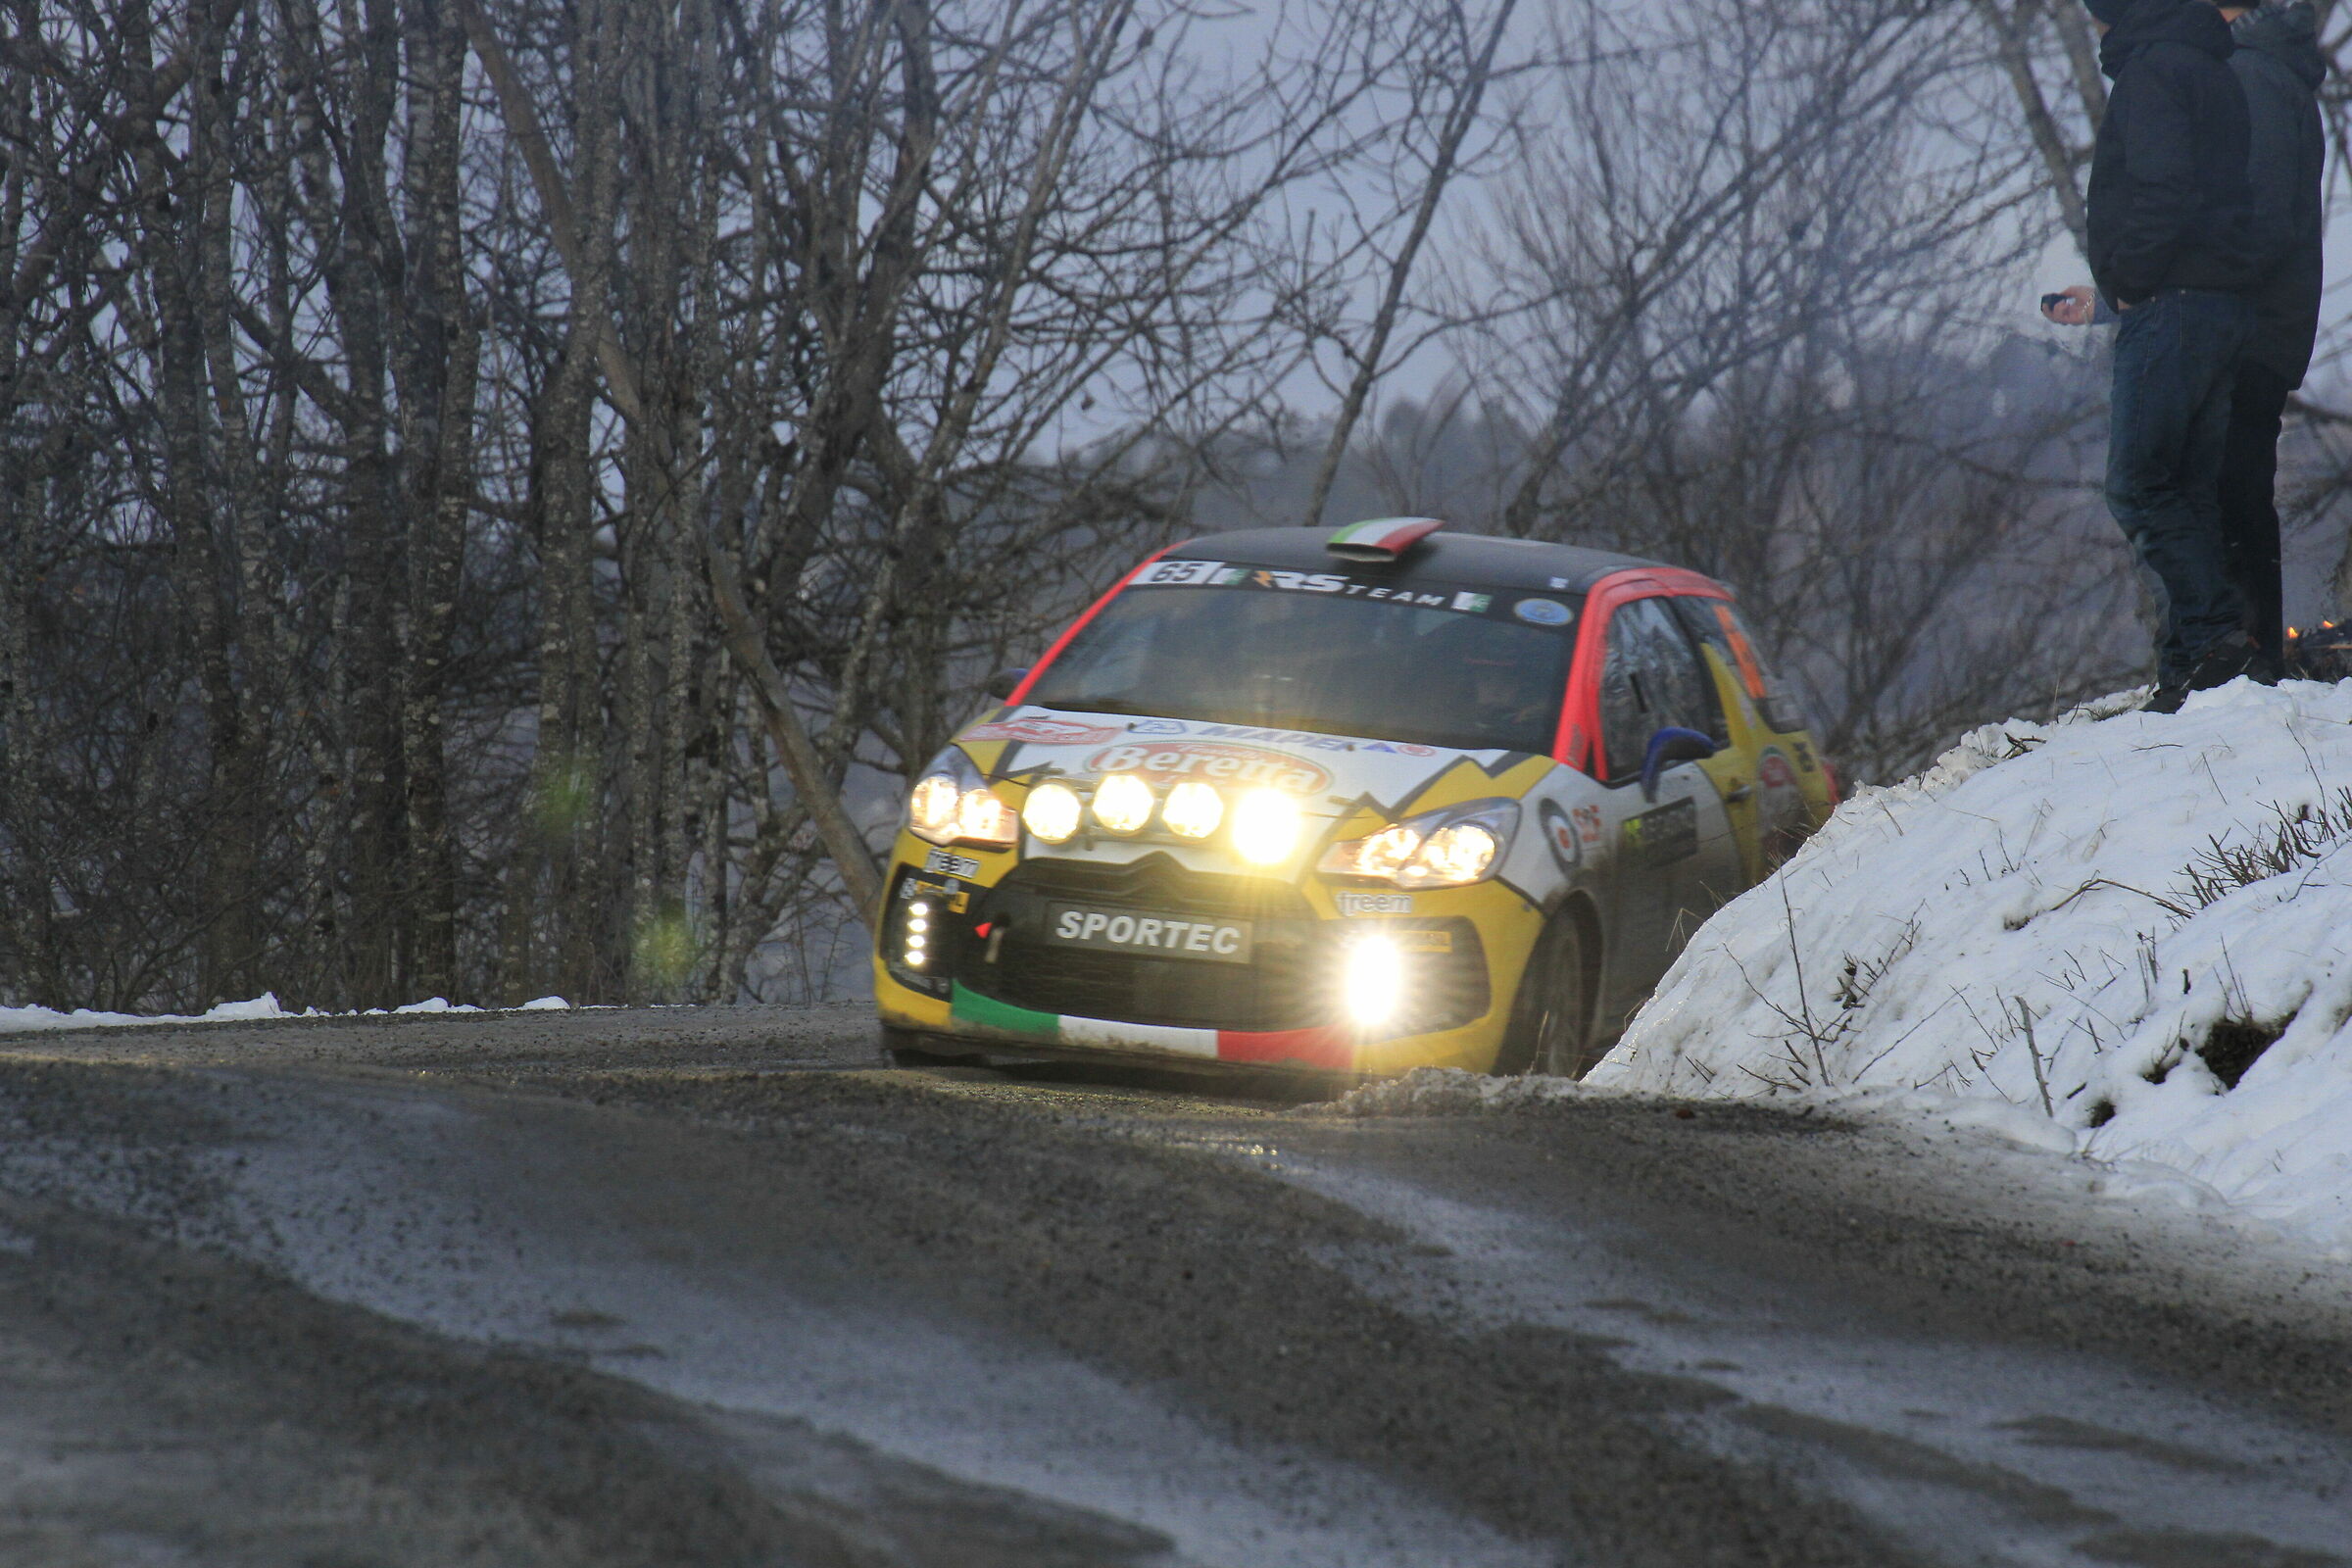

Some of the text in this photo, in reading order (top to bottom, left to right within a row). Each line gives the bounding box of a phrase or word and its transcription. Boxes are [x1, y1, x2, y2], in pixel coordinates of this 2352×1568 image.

[1152, 563, 1201, 582] 65
[1347, 585, 1446, 607] TEAM
[1099, 746, 1321, 786] Beretta
[1055, 910, 1241, 955] SPORTEC
